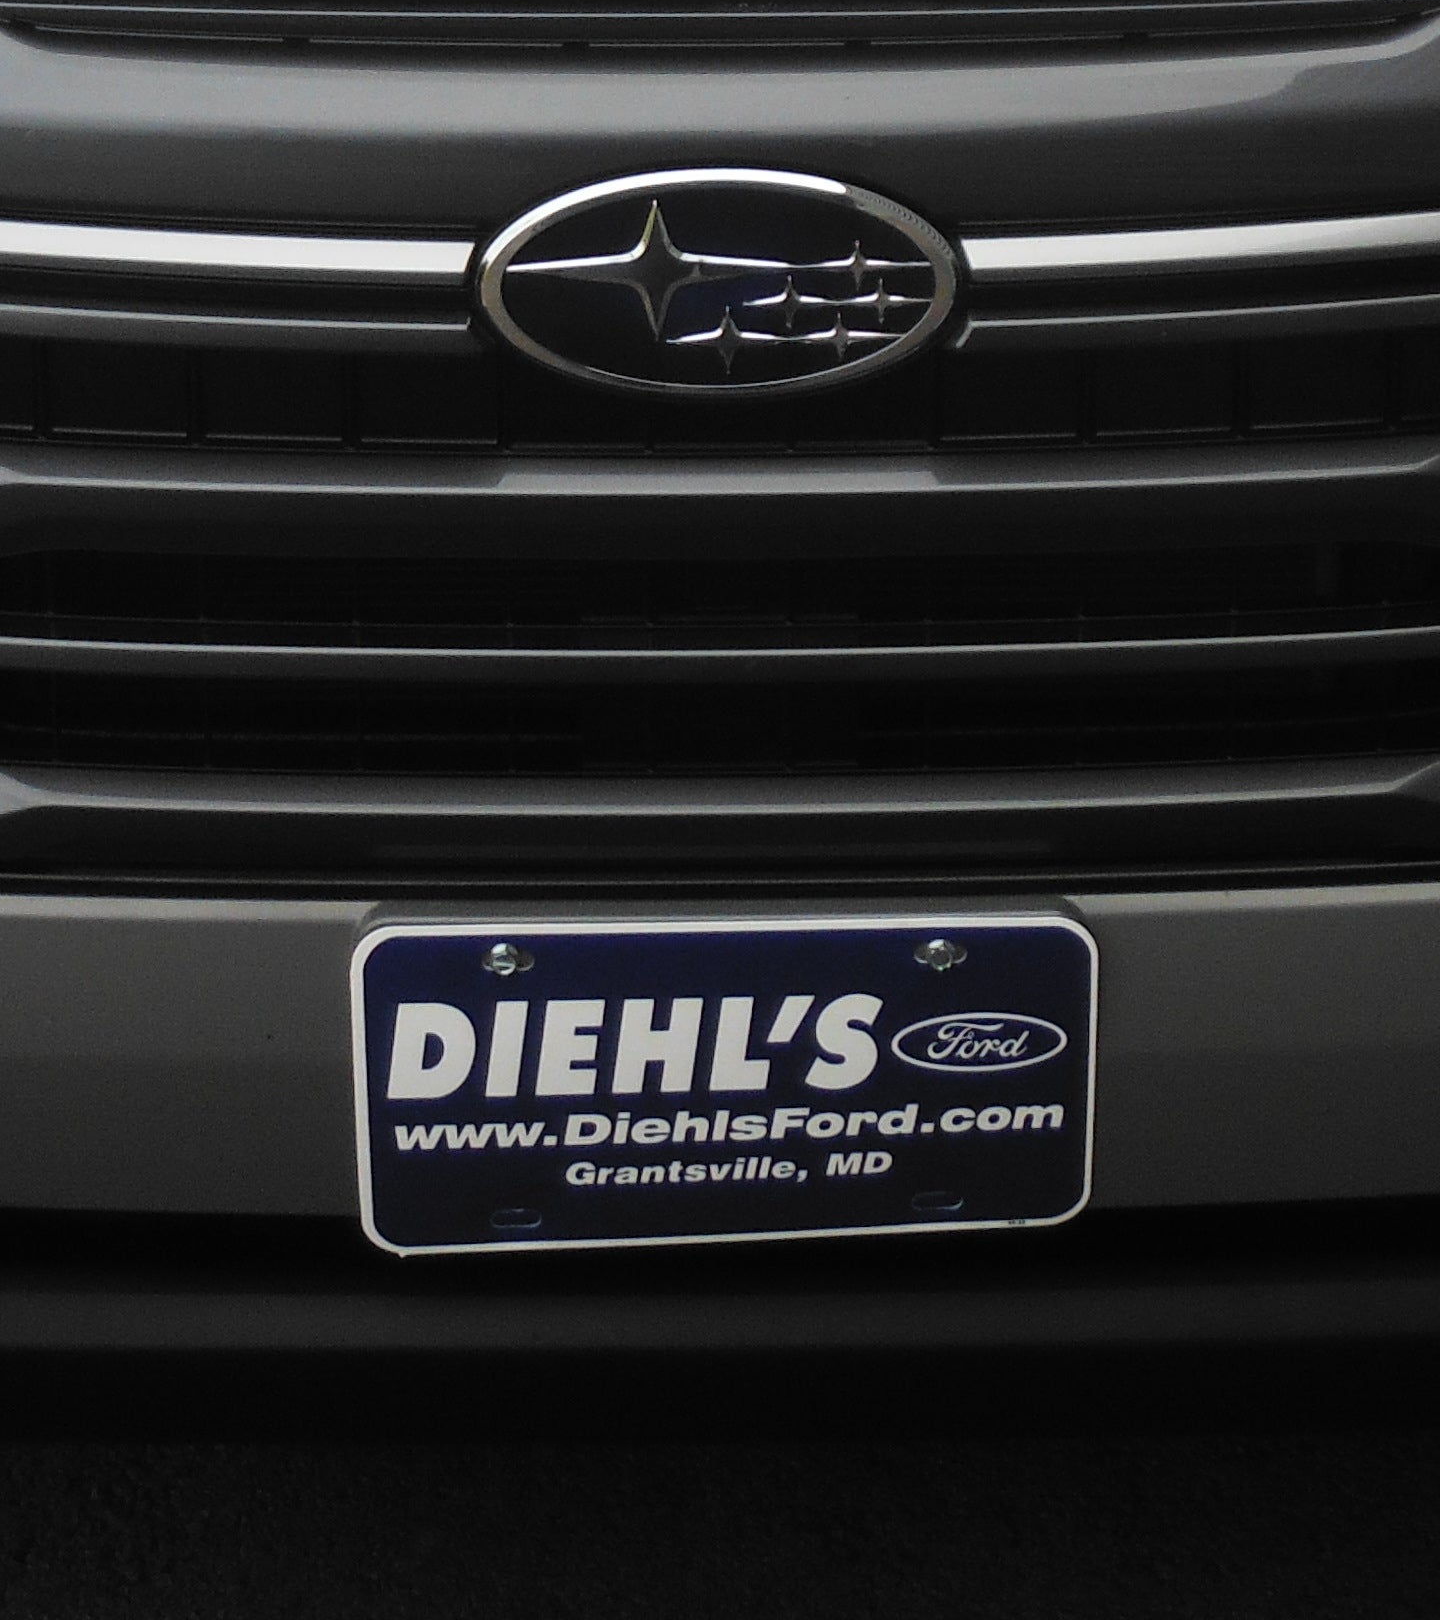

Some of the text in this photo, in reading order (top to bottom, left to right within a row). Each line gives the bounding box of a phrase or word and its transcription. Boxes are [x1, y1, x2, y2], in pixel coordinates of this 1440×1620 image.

[386, 993, 884, 1100] DIEHL'S
[927, 1022, 1029, 1060] Ford
[394, 1103, 1064, 1151] www.DiehlsFord.com
[565, 1151, 893, 1186] Grantsville, MD
